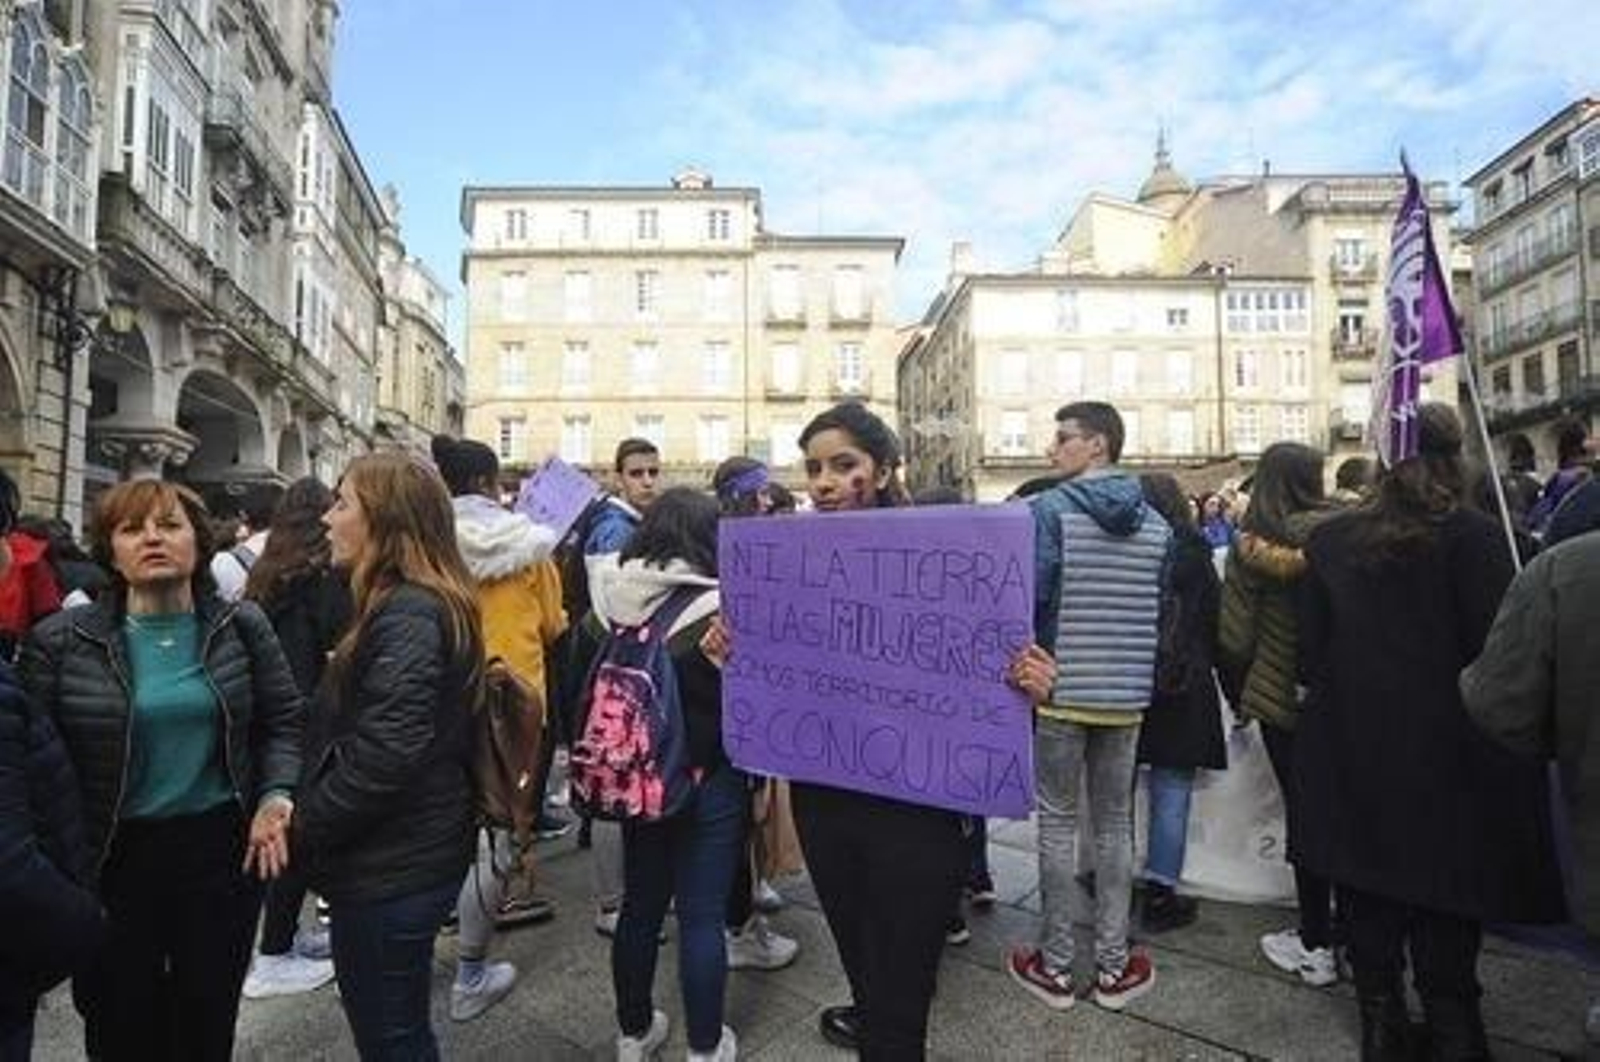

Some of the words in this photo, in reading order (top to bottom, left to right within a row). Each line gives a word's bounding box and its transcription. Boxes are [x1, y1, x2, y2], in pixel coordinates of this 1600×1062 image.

[731, 541, 783, 582] NI
[801, 545, 849, 588] LA
[852, 548, 1029, 607] TIERRA
[769, 600, 824, 647] LAS
[803, 670, 959, 717] TERRITORIO
[970, 703, 1012, 726] DE
[765, 708, 1030, 803] CONQUISTA
